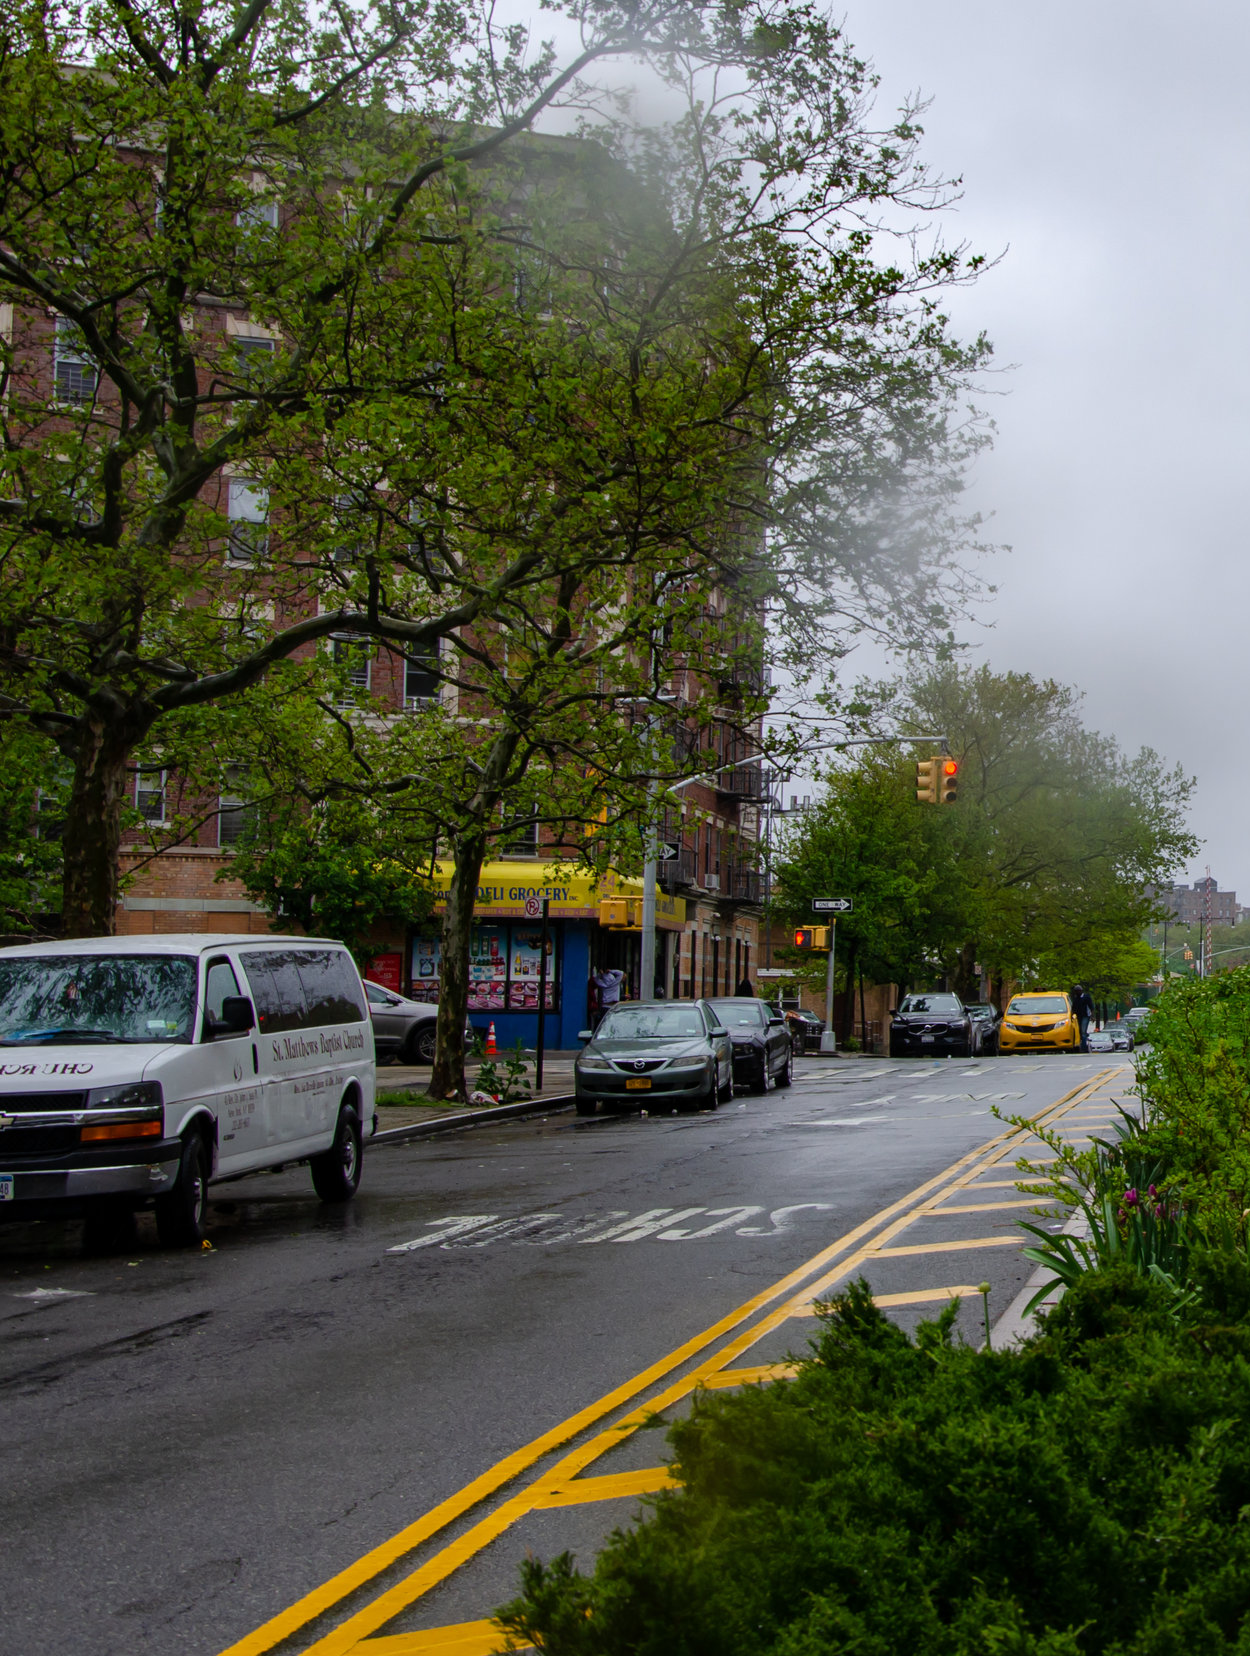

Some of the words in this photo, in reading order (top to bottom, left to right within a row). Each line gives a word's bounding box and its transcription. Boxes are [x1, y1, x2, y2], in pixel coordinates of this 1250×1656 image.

[600, 875, 615, 887] 24
[476, 886, 504, 901] DELI
[509, 886, 570, 901] GROCERY
[272, 1040, 284, 1061] St.
[284, 1036, 319, 1060] Matthews
[320, 1032, 342, 1057] Baptist
[343, 1028, 364, 1052] Church
